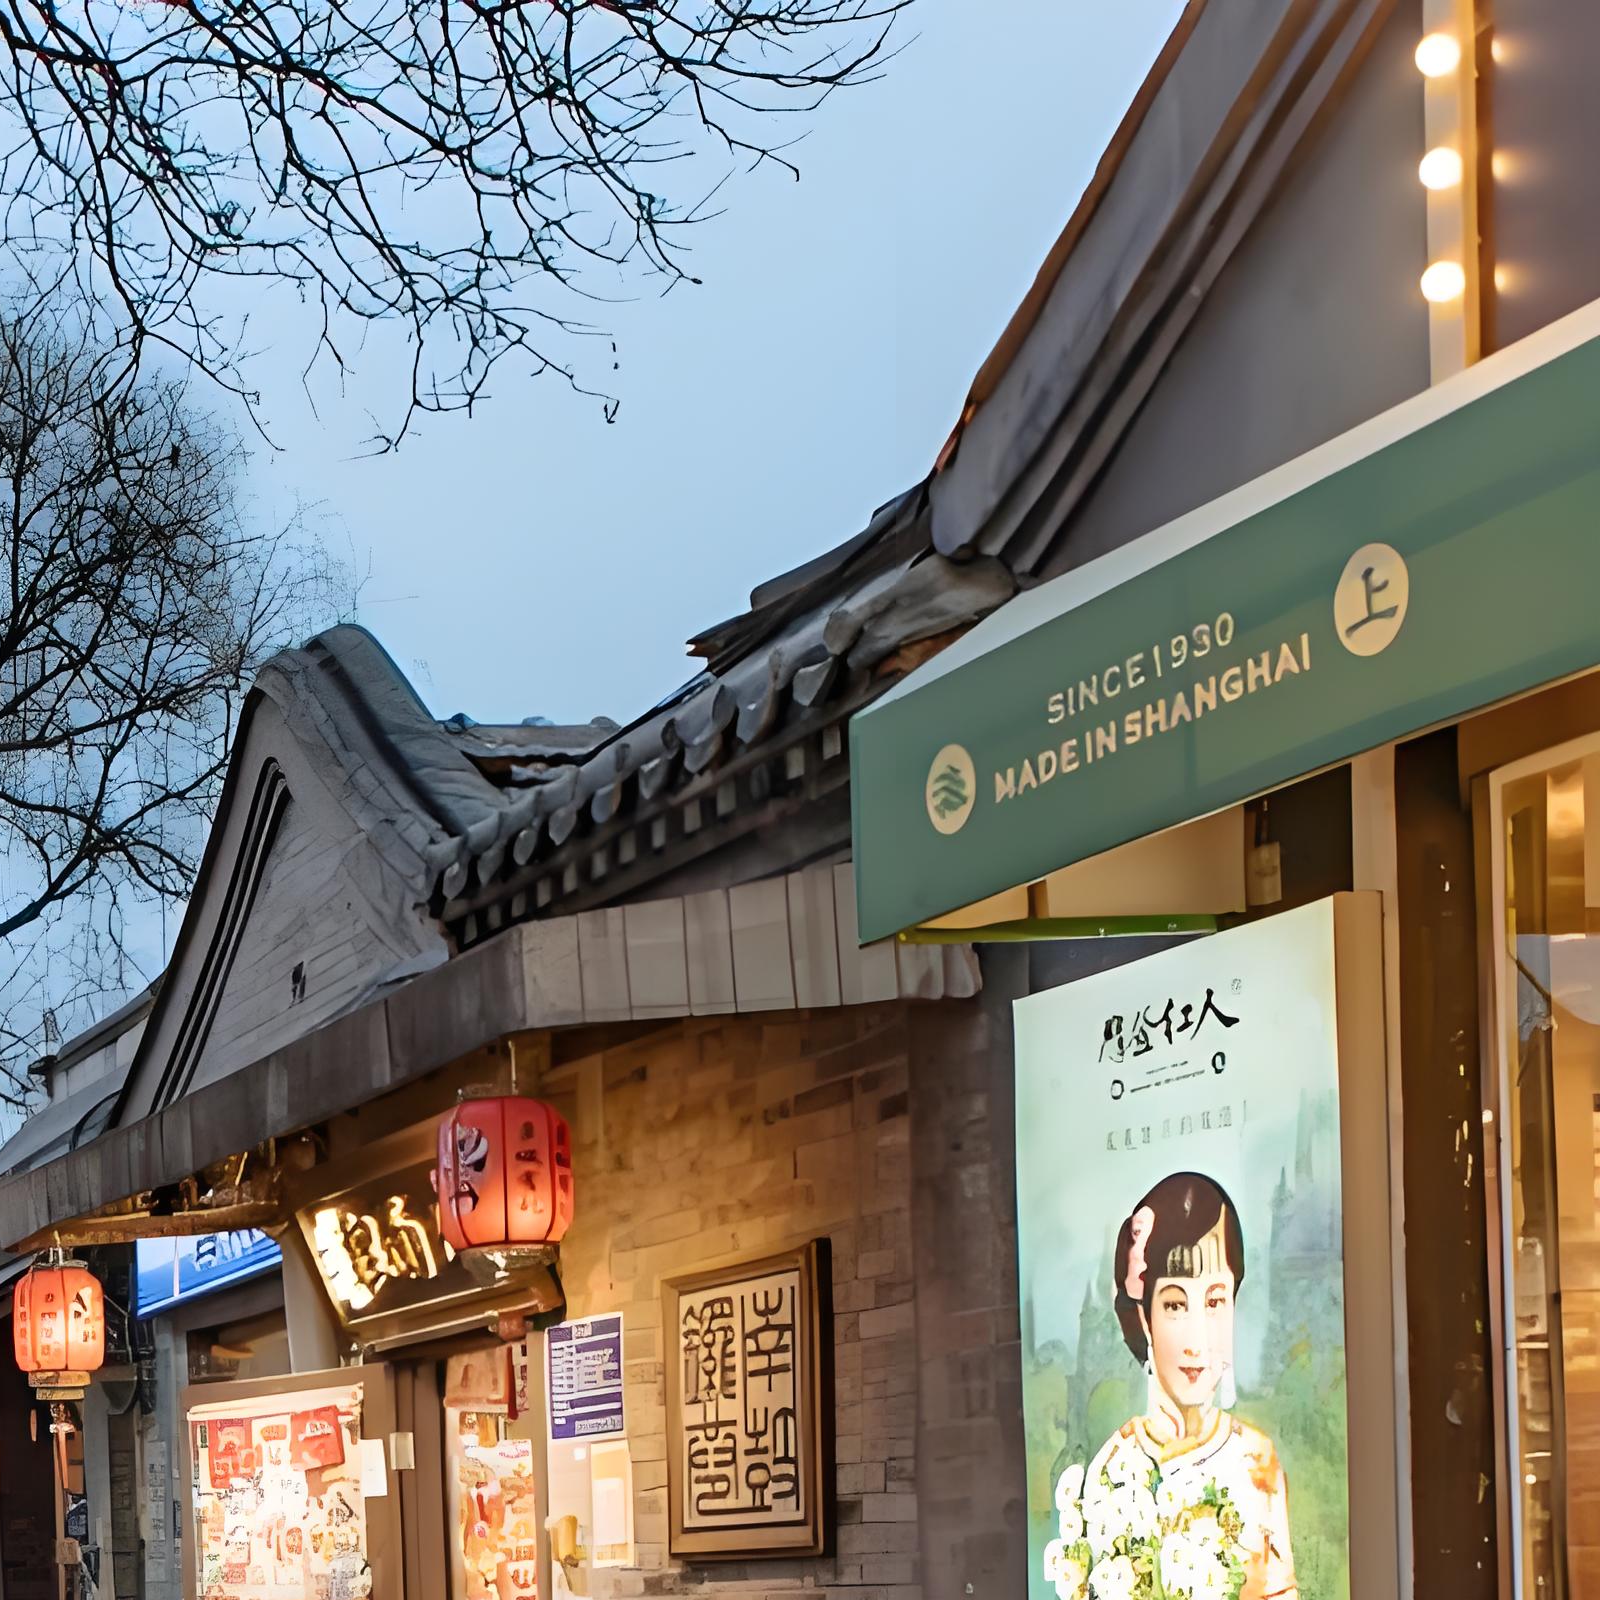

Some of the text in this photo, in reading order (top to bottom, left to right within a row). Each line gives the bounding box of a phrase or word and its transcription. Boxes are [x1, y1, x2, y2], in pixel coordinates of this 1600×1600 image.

[1344, 566, 1399, 639] 上
[994, 632, 1311, 804] MADE IN SHANGHAI
[1047, 652, 1146, 724] SINCE
